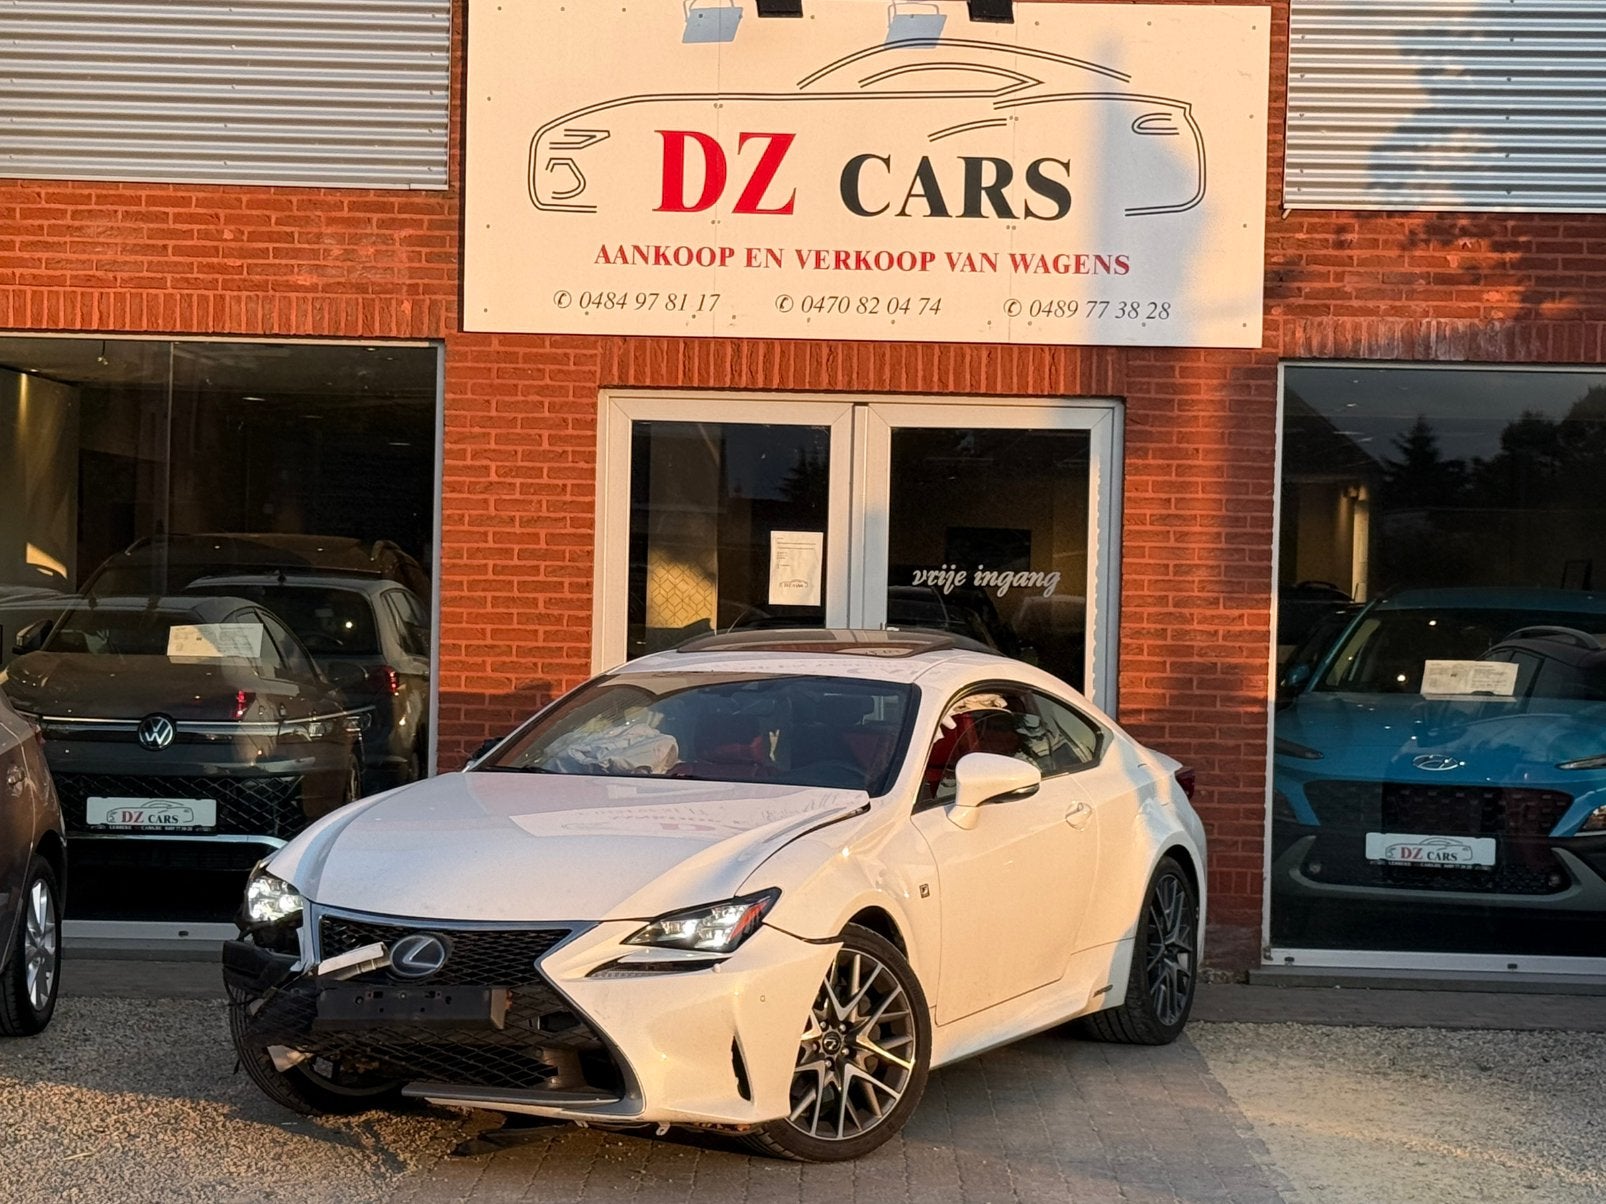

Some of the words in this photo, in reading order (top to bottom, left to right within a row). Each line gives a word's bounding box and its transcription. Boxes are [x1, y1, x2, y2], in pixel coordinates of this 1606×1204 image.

[652, 129, 797, 215] DZ
[839, 153, 1072, 221] CARS
[594, 244, 735, 267] AANKOOP
[744, 247, 784, 269] EN
[795, 249, 936, 272] VERKOOP
[944, 251, 999, 273] VAN
[1009, 253, 1130, 275] WAGENS
[579, 291, 628, 310] 0484
[634, 292, 660, 311] 97
[665, 293, 688, 311] 81
[696, 293, 721, 312] 17
[801, 295, 850, 314] 0470
[856, 296, 880, 314] 82
[886, 297, 911, 315] 04
[918, 297, 942, 316] 74
[1029, 299, 1079, 318] 0489
[1085, 300, 1110, 319] 77
[1115, 301, 1140, 319] 38
[1146, 301, 1171, 320] 28
[912, 564, 967, 595] vrije
[973, 564, 1061, 598] ingang
[121, 811, 144, 823] DZ
[148, 814, 179, 824] CARS
[1400, 847, 1423, 859] DZ
[1426, 851, 1458, 861] CARS
